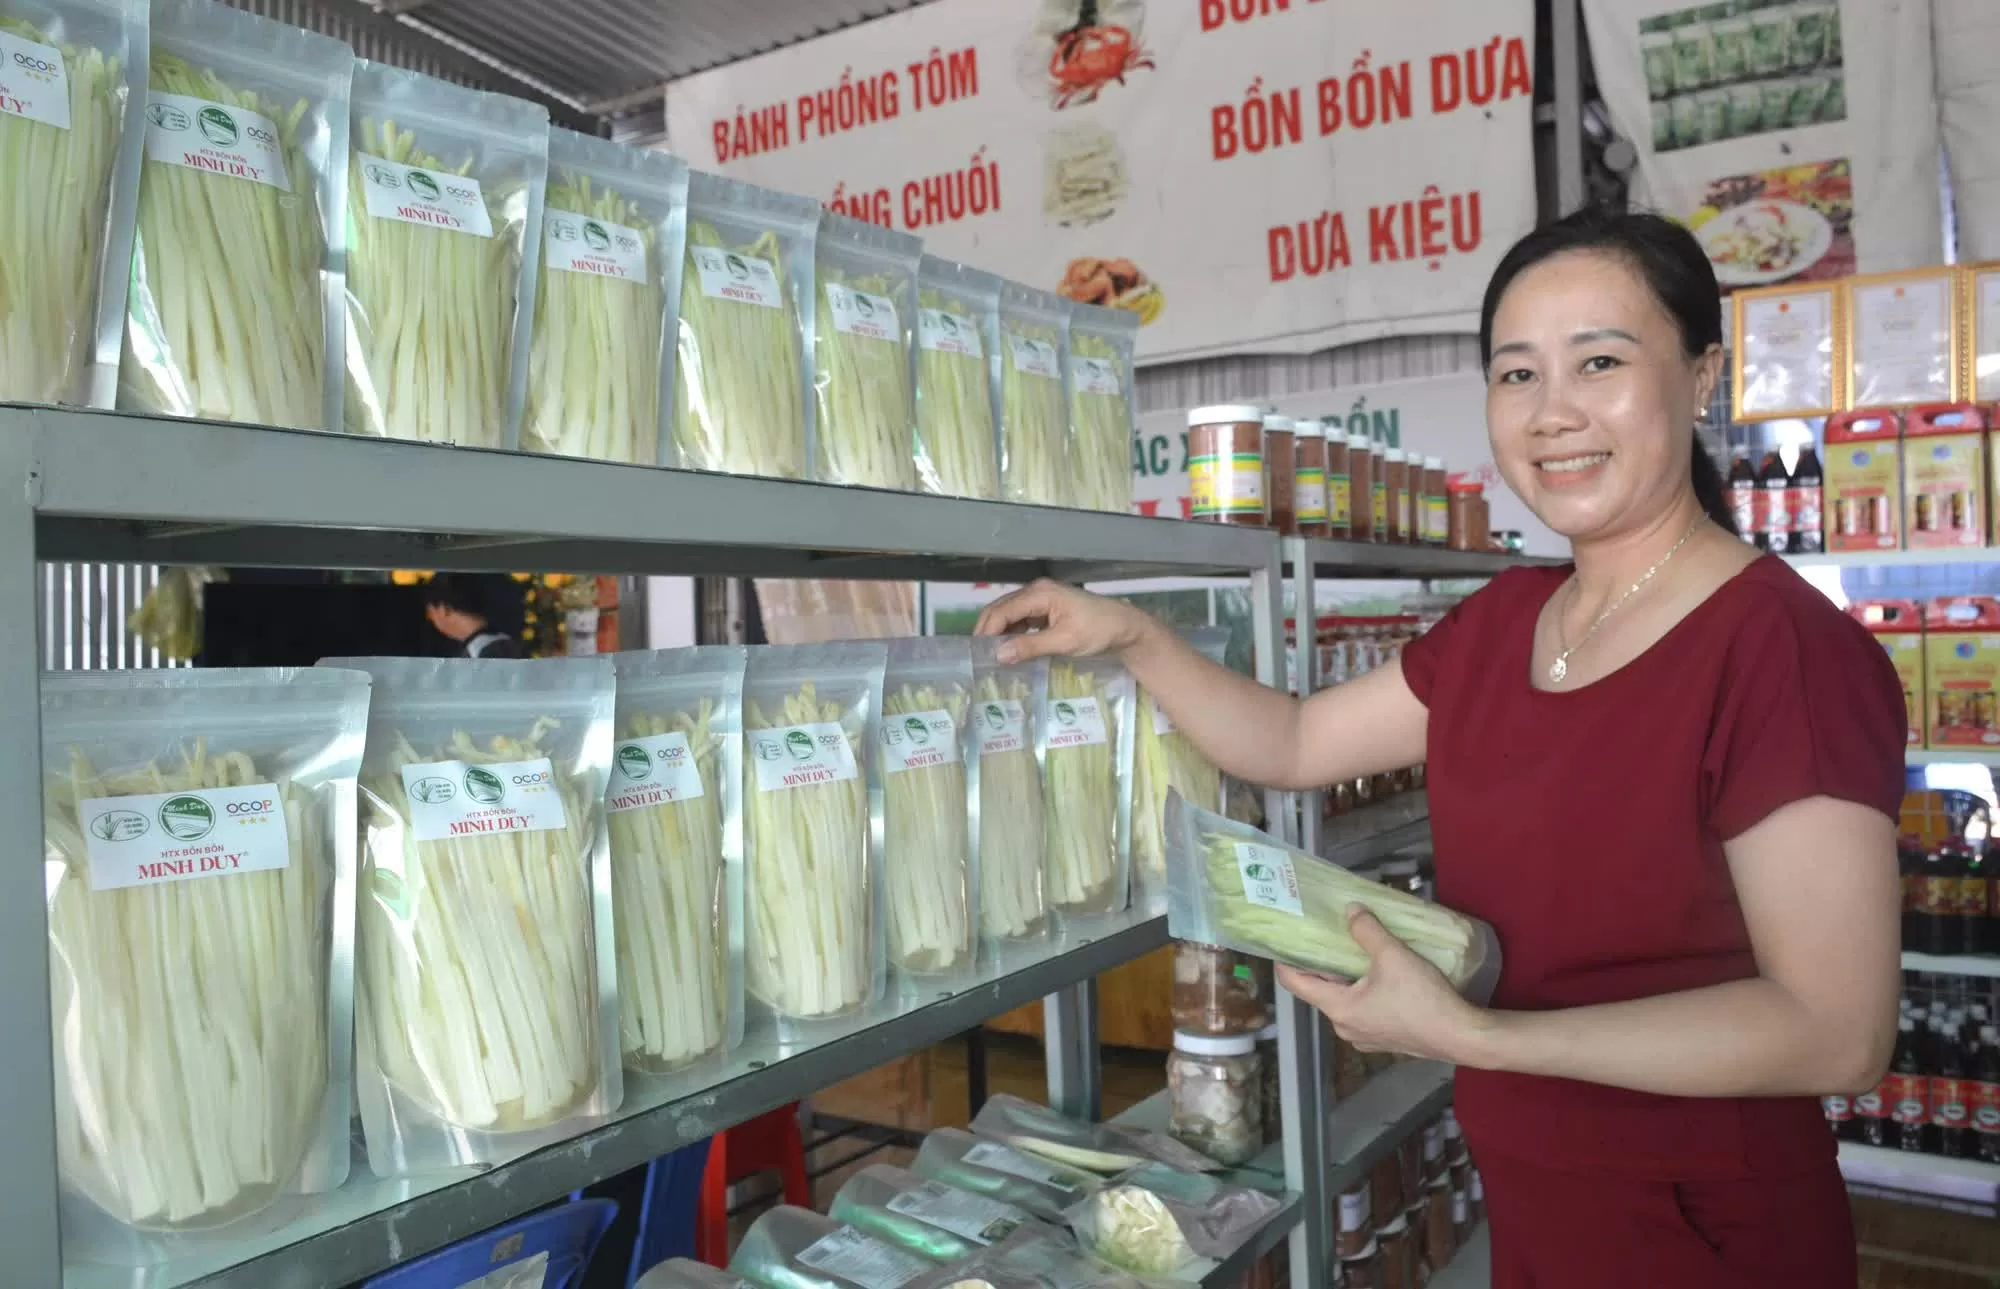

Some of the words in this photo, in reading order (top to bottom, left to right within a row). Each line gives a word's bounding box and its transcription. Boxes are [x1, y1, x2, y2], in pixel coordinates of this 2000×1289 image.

[14, 53, 56, 72] OCOP
[1430, 35, 1533, 115] DƯA
[713, 103, 789, 165] BÁNH
[907, 46, 979, 112] TÔM
[184, 152, 225, 172] MINH
[229, 161, 260, 179] DUY
[821, 180, 892, 230] ỒNG
[902, 144, 1000, 230] CHUỐI
[397, 206, 432, 222] MINH
[435, 213, 461, 227] DUY
[1267, 210, 1351, 282] DƯA
[1368, 185, 1482, 272] KIỆU
[571, 259, 601, 273] MINH
[512, 771, 548, 785] OCOP
[226, 800, 272, 814] OCOP
[611, 794, 646, 809] MINH
[648, 789, 673, 803] DUY
[450, 820, 494, 835] MINH
[498, 815, 530, 830] DUY
[161, 850, 180, 858] HTX
[137, 859, 193, 879] MINH
[200, 853, 241, 872] DUY
